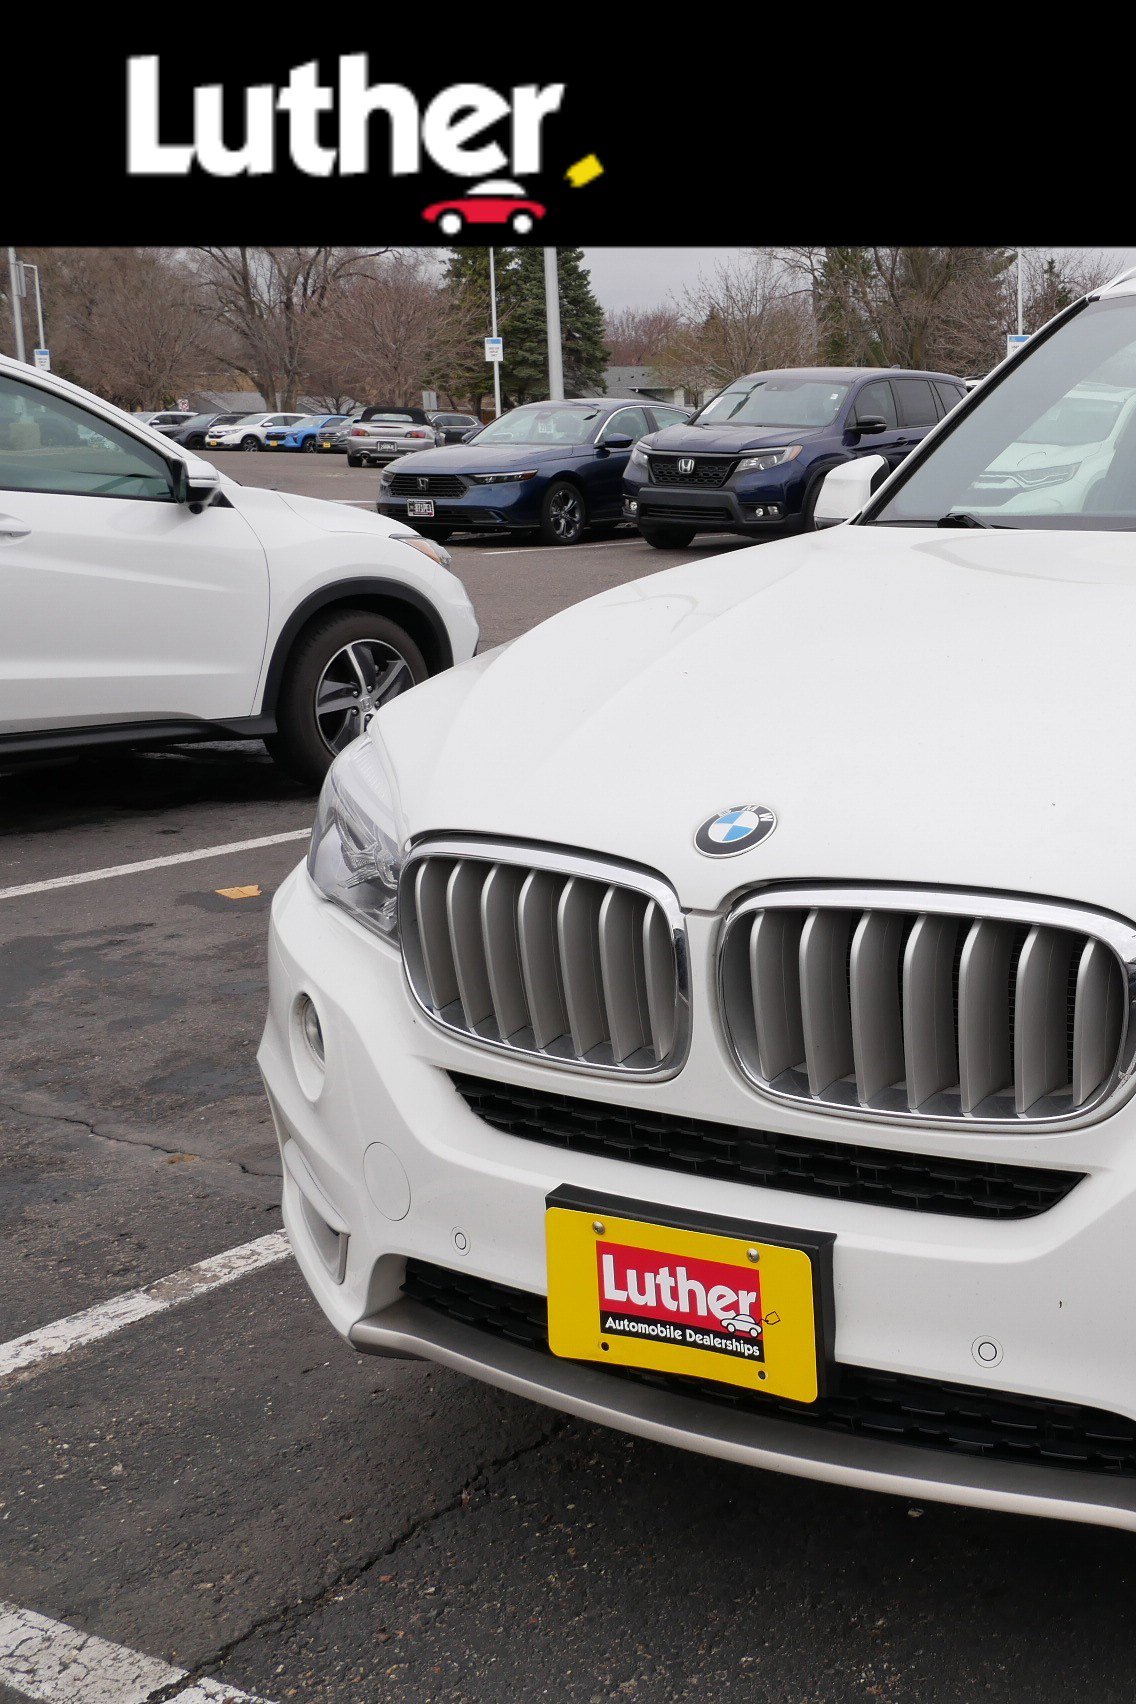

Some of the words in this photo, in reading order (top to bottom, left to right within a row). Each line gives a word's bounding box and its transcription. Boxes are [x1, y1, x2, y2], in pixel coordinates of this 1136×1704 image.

[602, 1253, 757, 1321] Luther
[605, 1316, 683, 1340] Automobile
[685, 1329, 760, 1356] Dealerships
